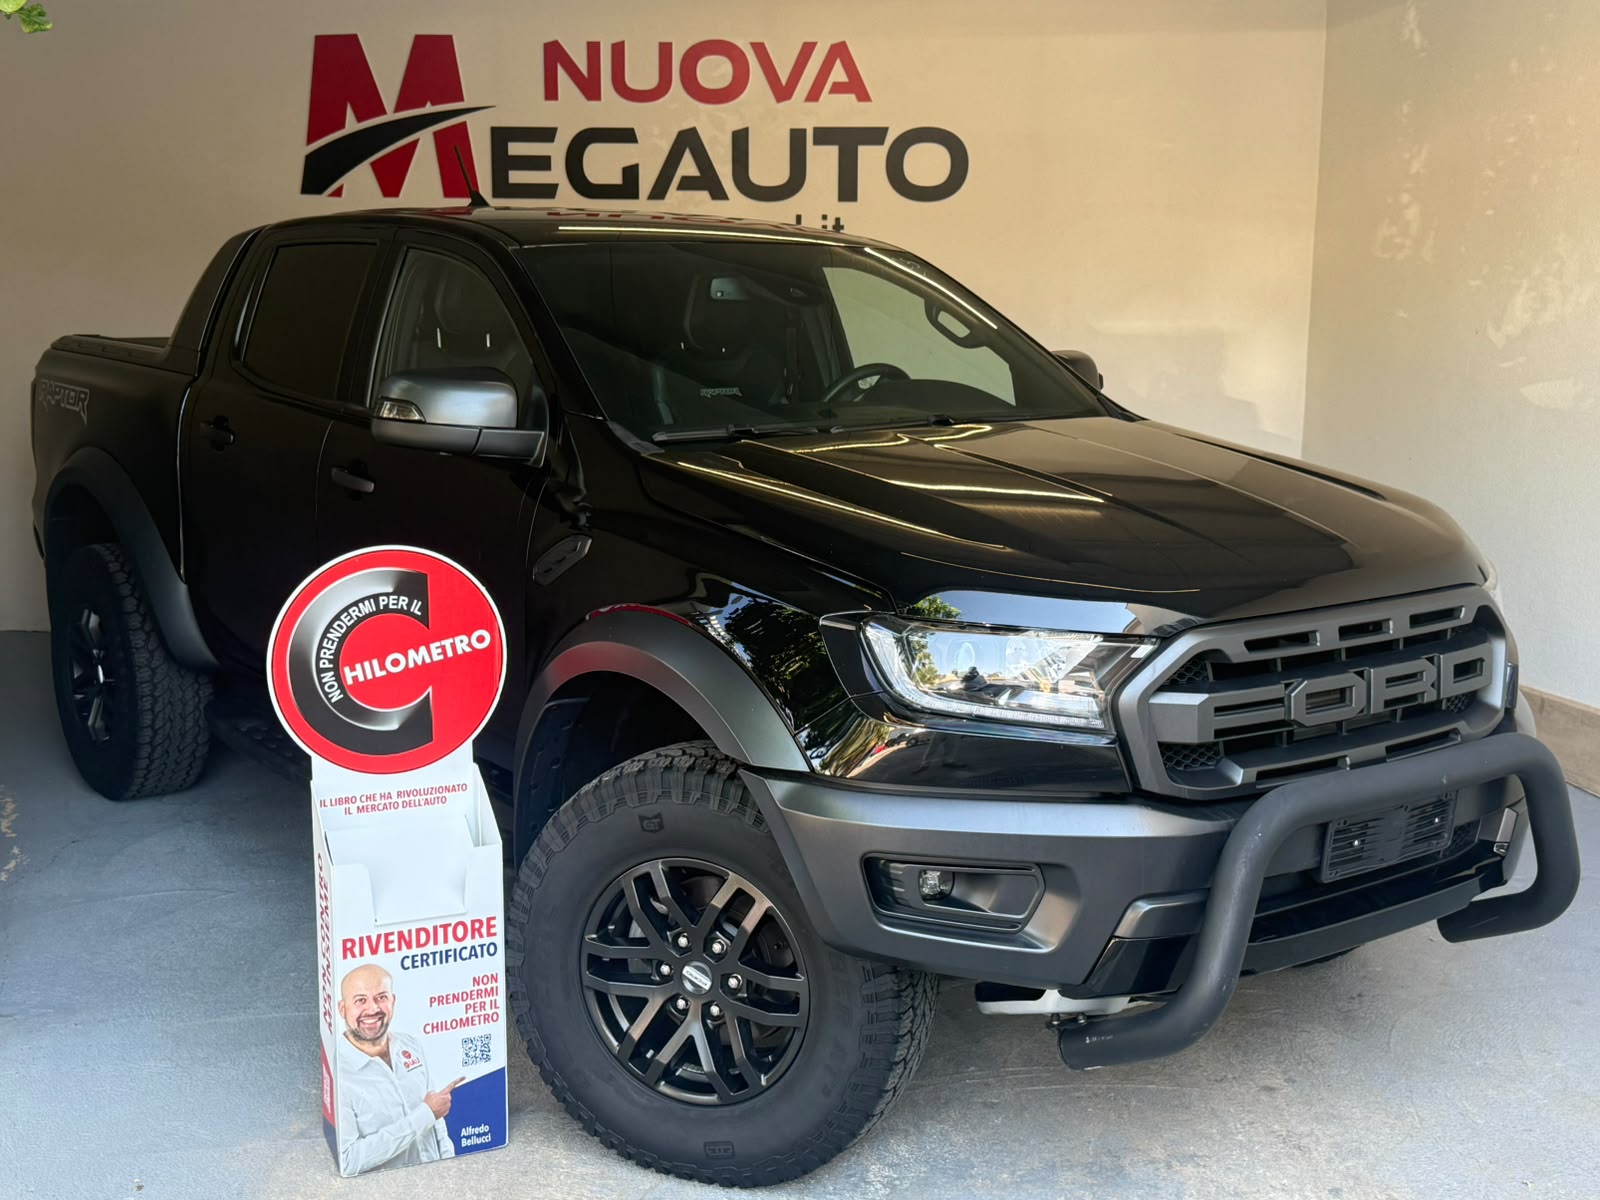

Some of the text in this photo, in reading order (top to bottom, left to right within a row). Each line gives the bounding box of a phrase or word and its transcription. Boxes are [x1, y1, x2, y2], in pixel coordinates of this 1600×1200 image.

[543, 39, 872, 105] NUOVA
[319, 595, 422, 703] NON PRENDERMI PER IL
[1148, 642, 1493, 744] FORD
[319, 783, 468, 809] IL LIBRO CHE HA RIVOLUZIONATO
[344, 795, 447, 816] IL MERCATO DELL'AUTO
[342, 916, 498, 960] RIVENDITORE
[400, 941, 498, 971] CERTIFICATO
[472, 972, 499, 988] NON
[429, 986, 499, 1008] PRENDERMI
[465, 998, 500, 1014] PER IL
[423, 1011, 500, 1035] CHILOMETRO
[460, 1123, 490, 1137] Alfredo
[461, 1132, 492, 1148] Bellucci
